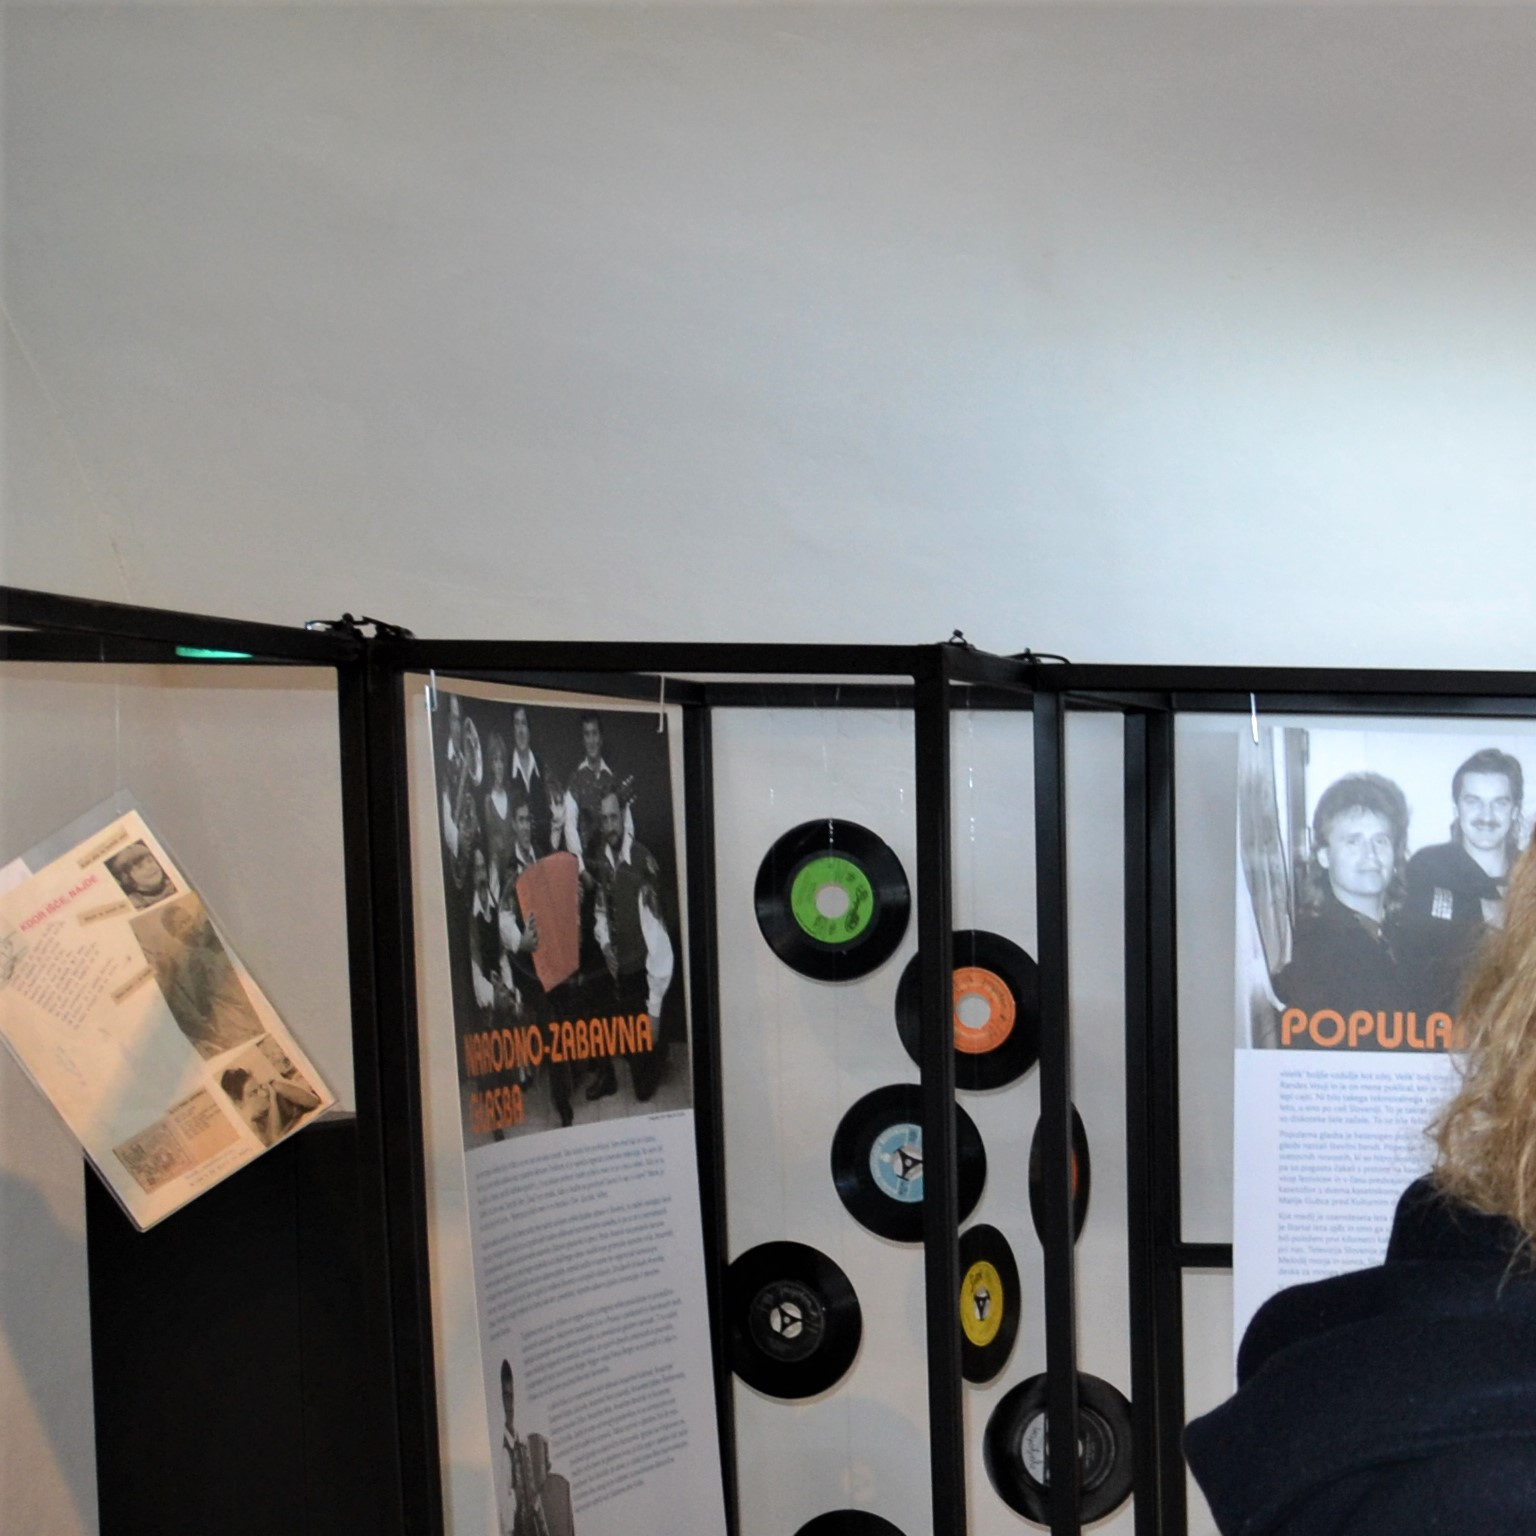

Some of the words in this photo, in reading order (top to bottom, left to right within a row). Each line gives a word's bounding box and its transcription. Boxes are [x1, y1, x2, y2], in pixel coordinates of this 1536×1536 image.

[19, 910, 47, 932] KDOR
[464, 1013, 653, 1077] NARODNO-ZABAVNA
[1281, 1007, 1466, 1050] POPULA
